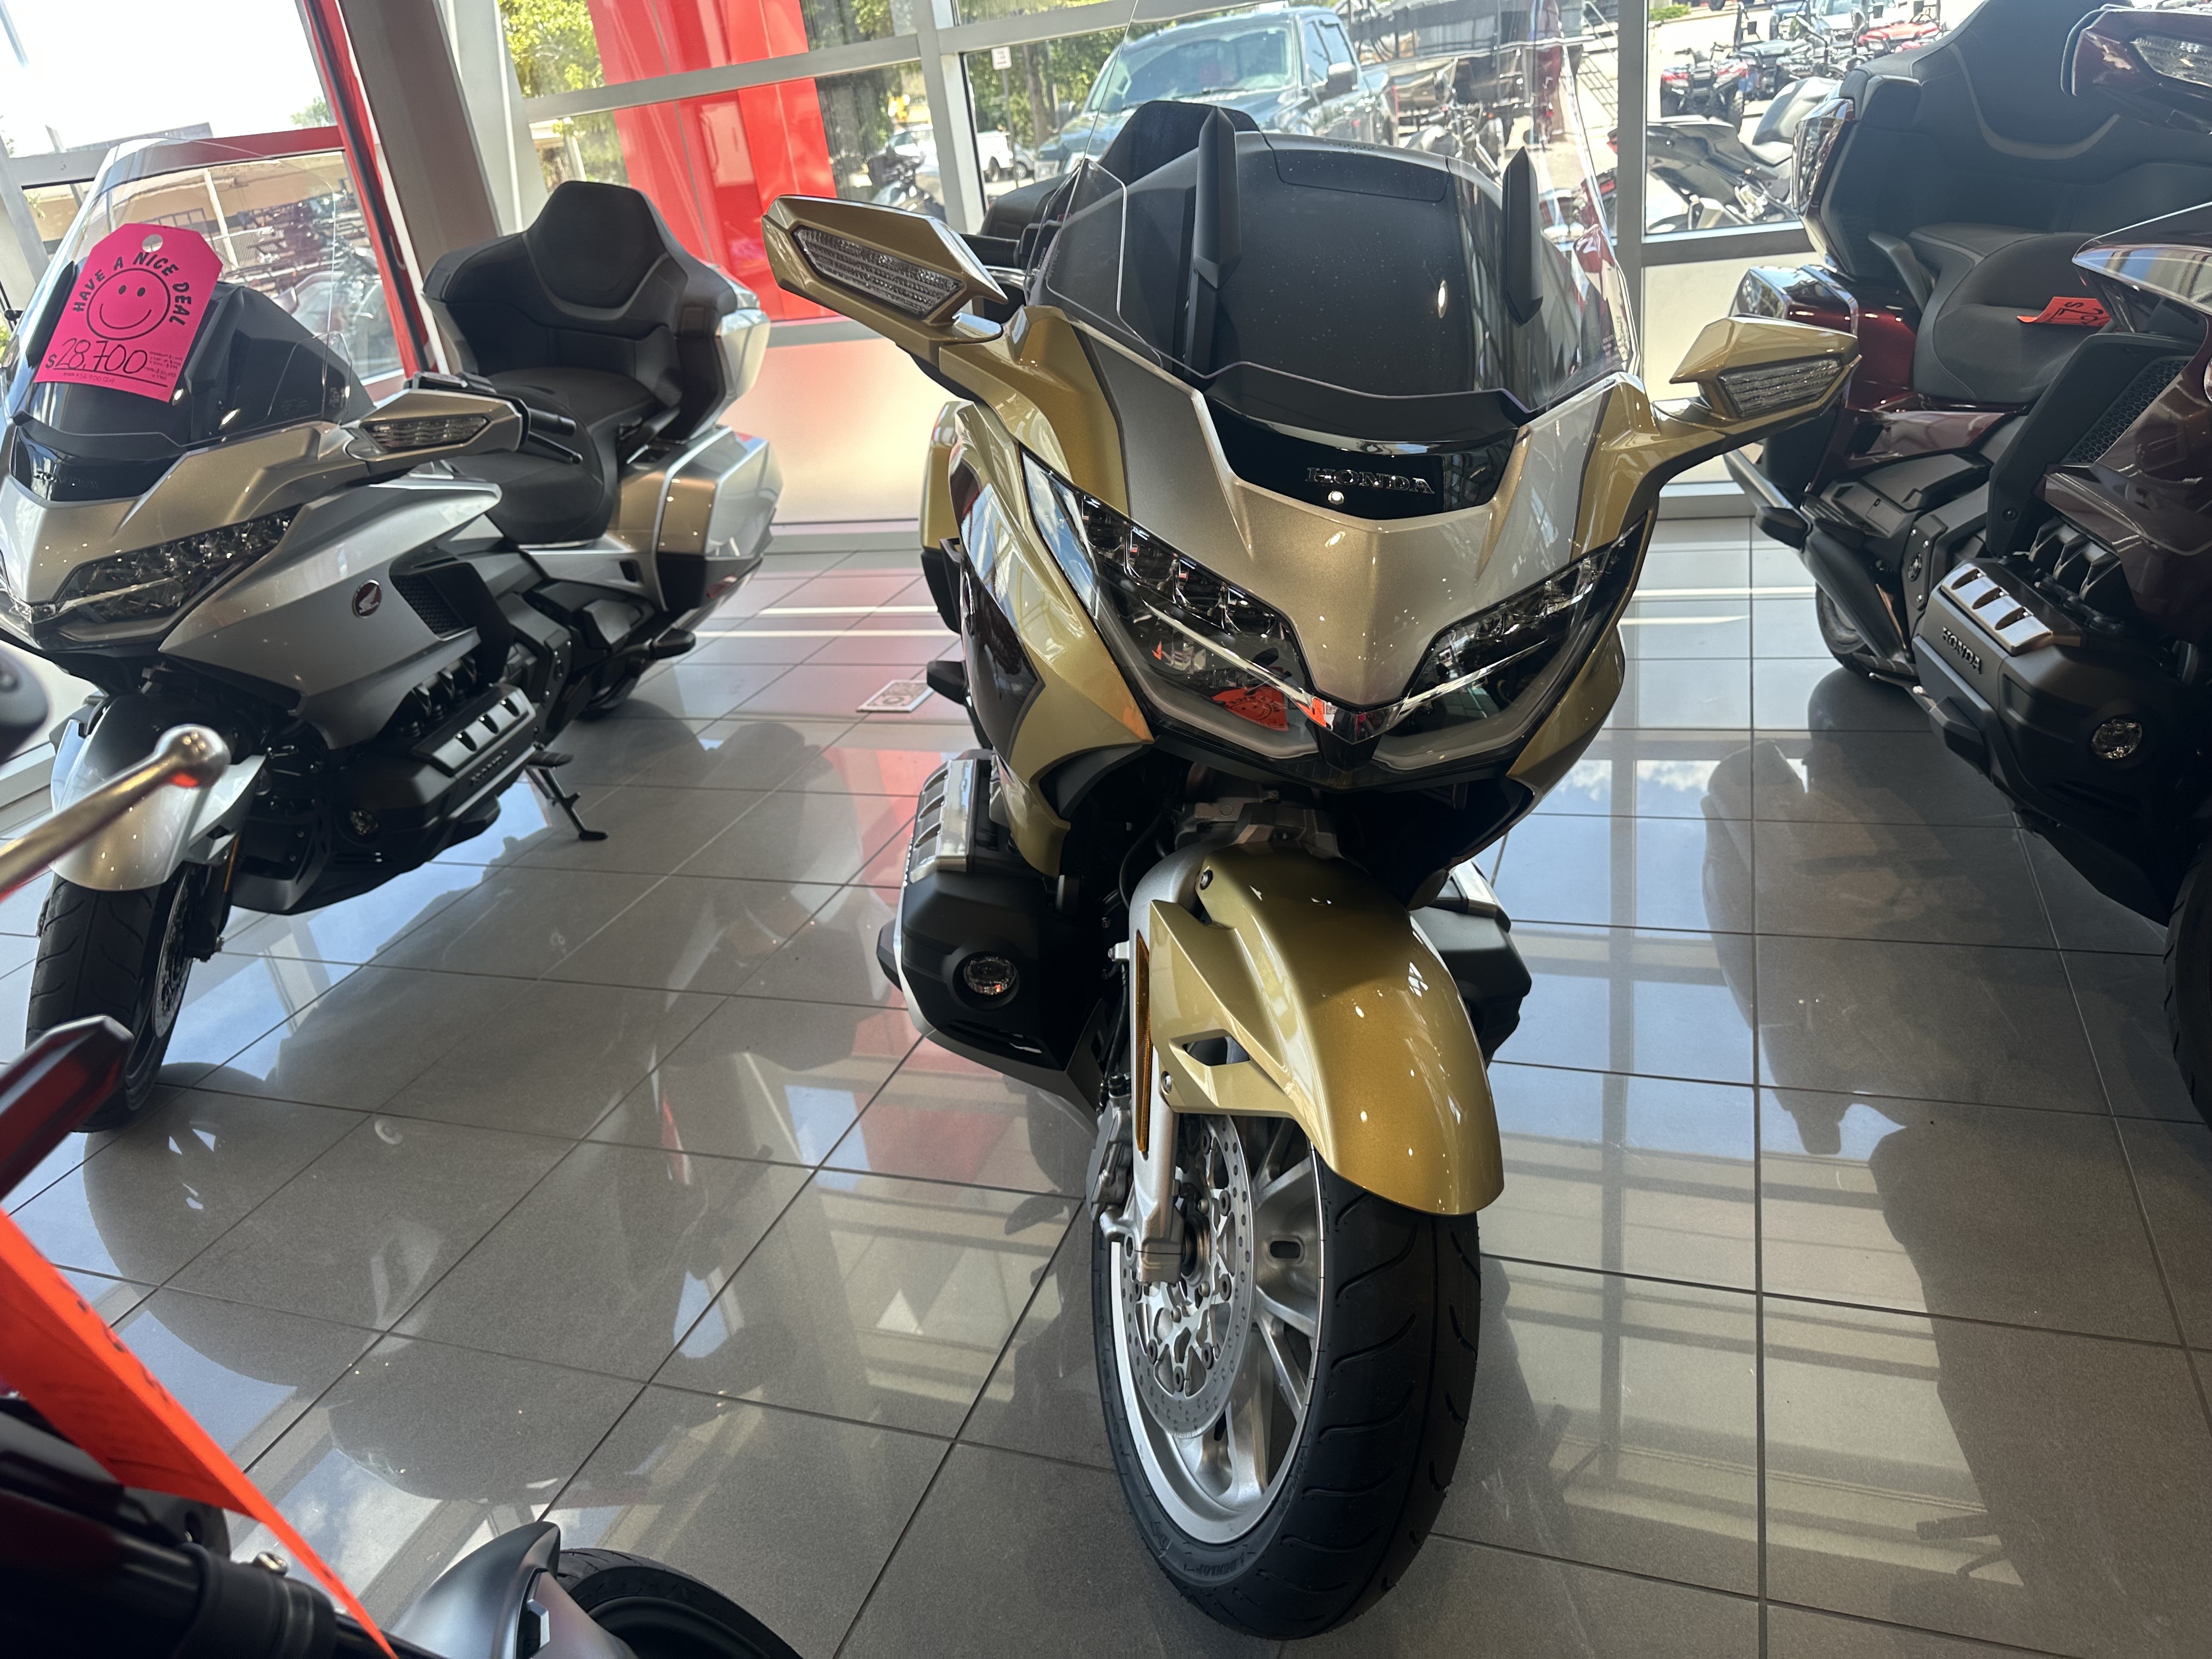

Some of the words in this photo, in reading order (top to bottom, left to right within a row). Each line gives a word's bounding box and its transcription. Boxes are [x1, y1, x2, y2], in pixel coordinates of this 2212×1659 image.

[72, 269, 106, 312] HAVE
[114, 256, 124, 271] A
[133, 252, 179, 276] NICE
[169, 282, 191, 326] DEAL
[1305, 467, 1435, 494] HONDA
[1942, 626, 1983, 675] HONDA
